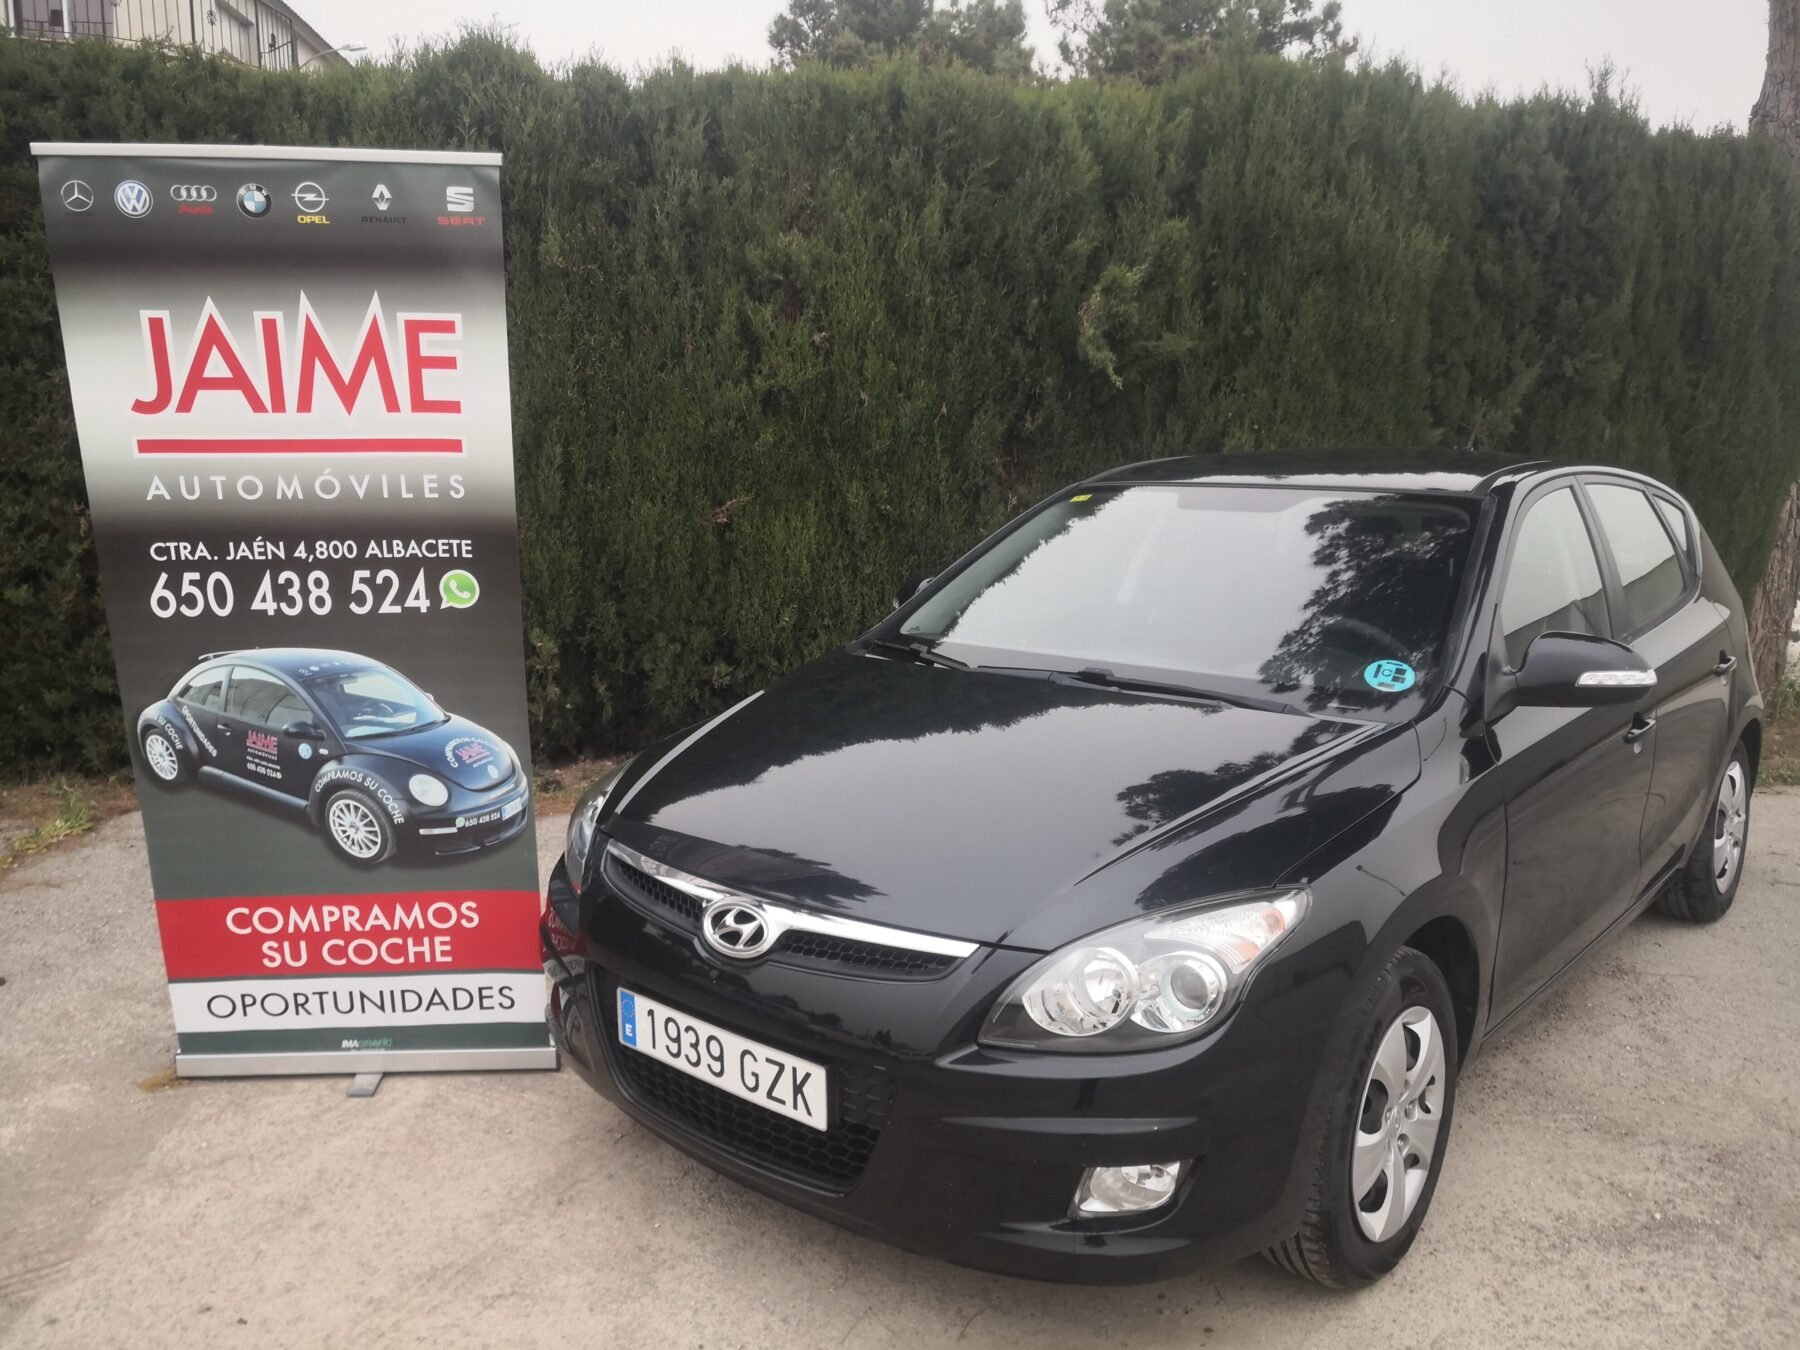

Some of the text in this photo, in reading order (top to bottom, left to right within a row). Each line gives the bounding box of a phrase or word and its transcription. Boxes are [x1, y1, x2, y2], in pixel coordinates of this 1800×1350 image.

[297, 215, 330, 225] OPEL
[361, 216, 408, 225] RENAULT
[437, 216, 485, 226] SEAT
[130, 293, 463, 416] JAIME
[146, 468, 466, 501] AUTOMÓVILES
[149, 536, 474, 564] CTRA. JAÉN 4,800 ALBACETE
[149, 566, 431, 619] 650 438 524
[164, 723, 184, 751] COCHE
[247, 730, 277, 752] JAIME
[315, 770, 405, 825] COMPRAMOS SU COCHE
[465, 818, 478, 827] 650
[225, 900, 480, 936] COMPRAMOS
[261, 935, 453, 968] SU COCHE
[205, 985, 517, 1020] OPORTUNIDADES
[625, 1023, 633, 1037] E
[646, 1008, 813, 1118] 1939 GZK
